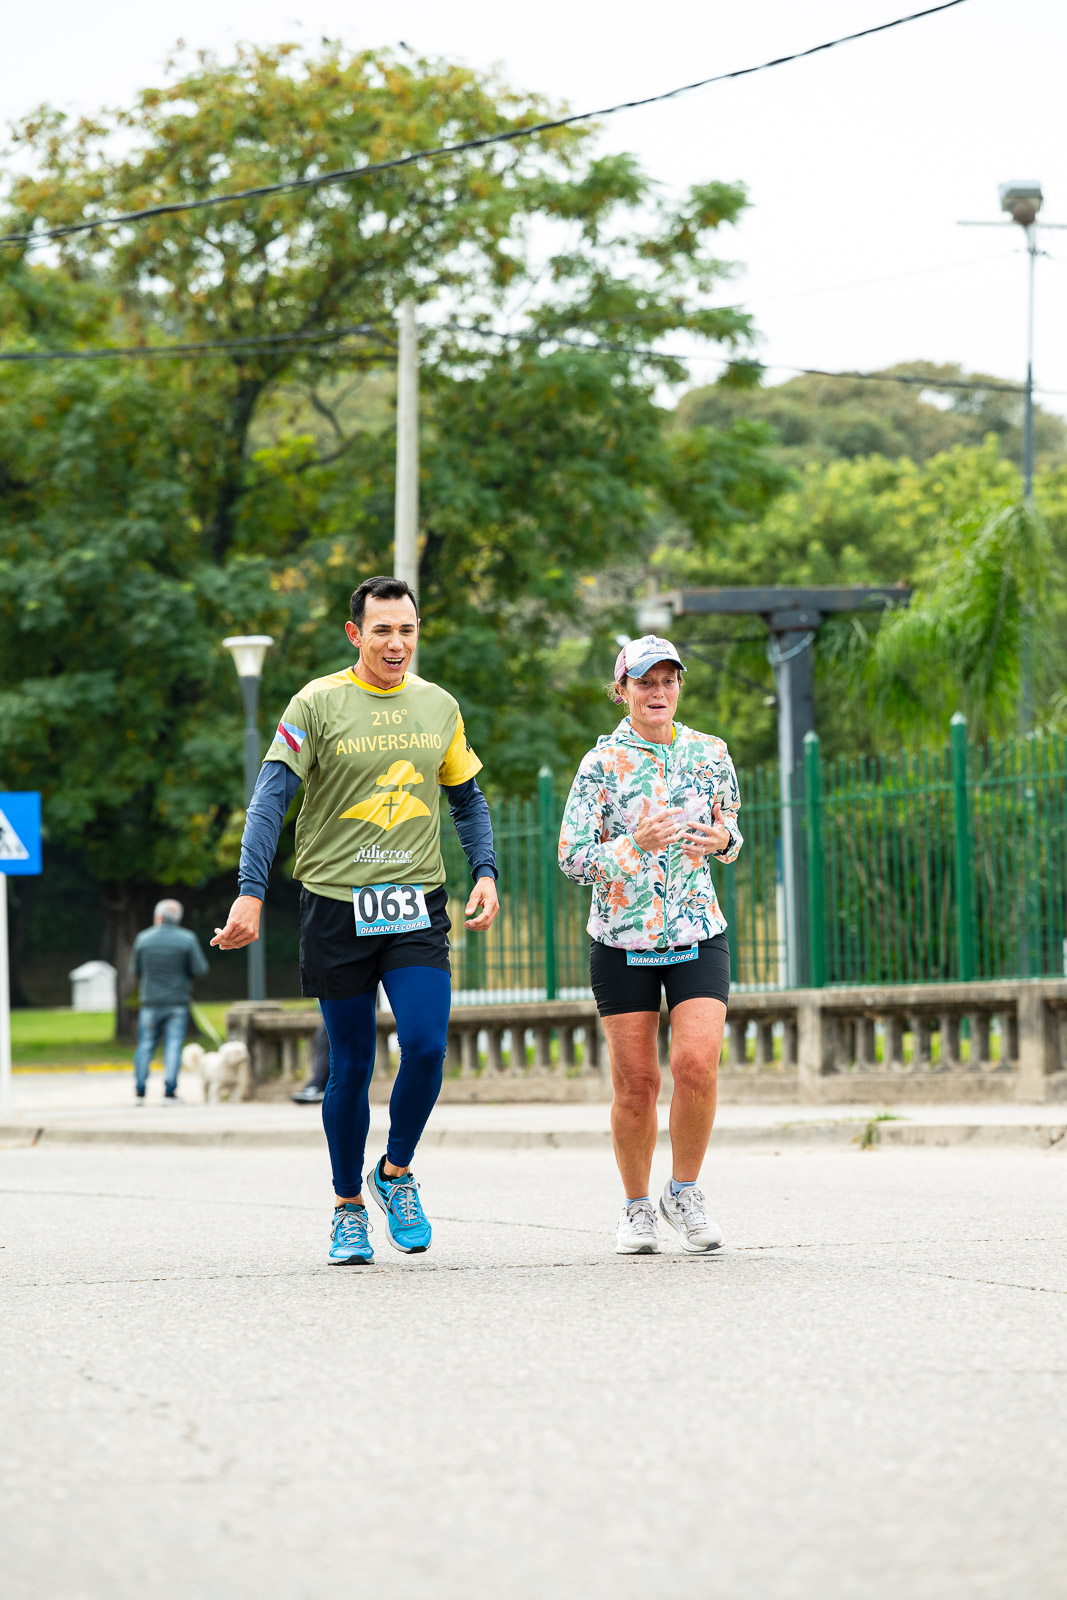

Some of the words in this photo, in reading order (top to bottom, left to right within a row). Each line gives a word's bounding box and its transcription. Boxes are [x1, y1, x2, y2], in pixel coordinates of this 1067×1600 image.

[371, 708, 408, 726] 216°
[336, 733, 442, 755] ANIVERSARIO
[353, 844, 413, 863] julicroc
[358, 885, 420, 924] 063
[360, 924, 400, 934] DIAMANTE
[401, 920, 427, 931] CORRE
[630, 956, 669, 964] DIAMANTE
[670, 952, 695, 963] CORRE
